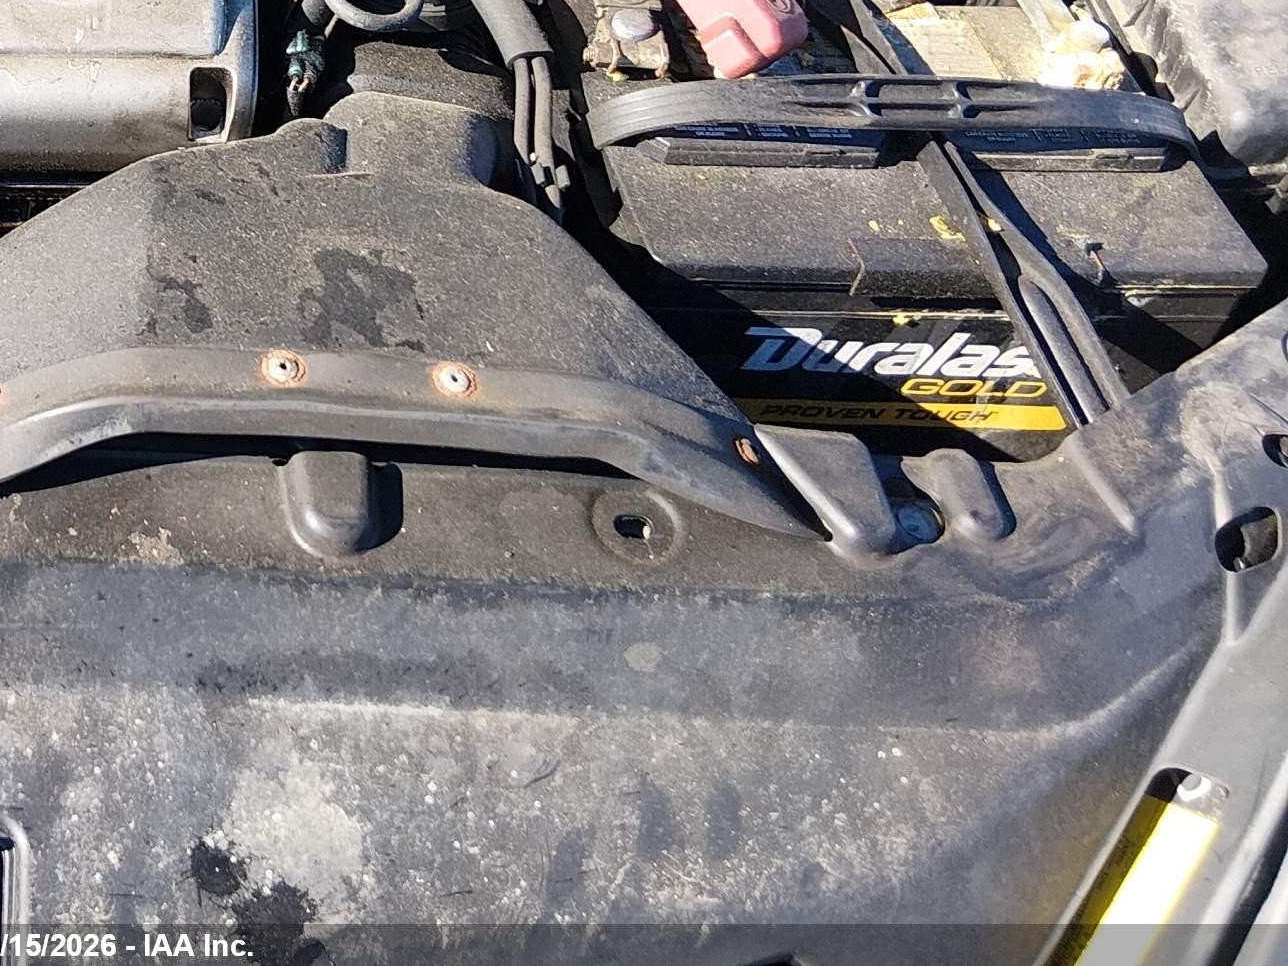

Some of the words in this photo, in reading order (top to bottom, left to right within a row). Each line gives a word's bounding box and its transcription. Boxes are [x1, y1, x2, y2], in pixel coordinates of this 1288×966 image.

[741, 326, 1043, 379] Duralas
[901, 378, 1048, 398] GOLD
[760, 404, 887, 422] PROVEN
[892, 408, 996, 423] TOUGH
